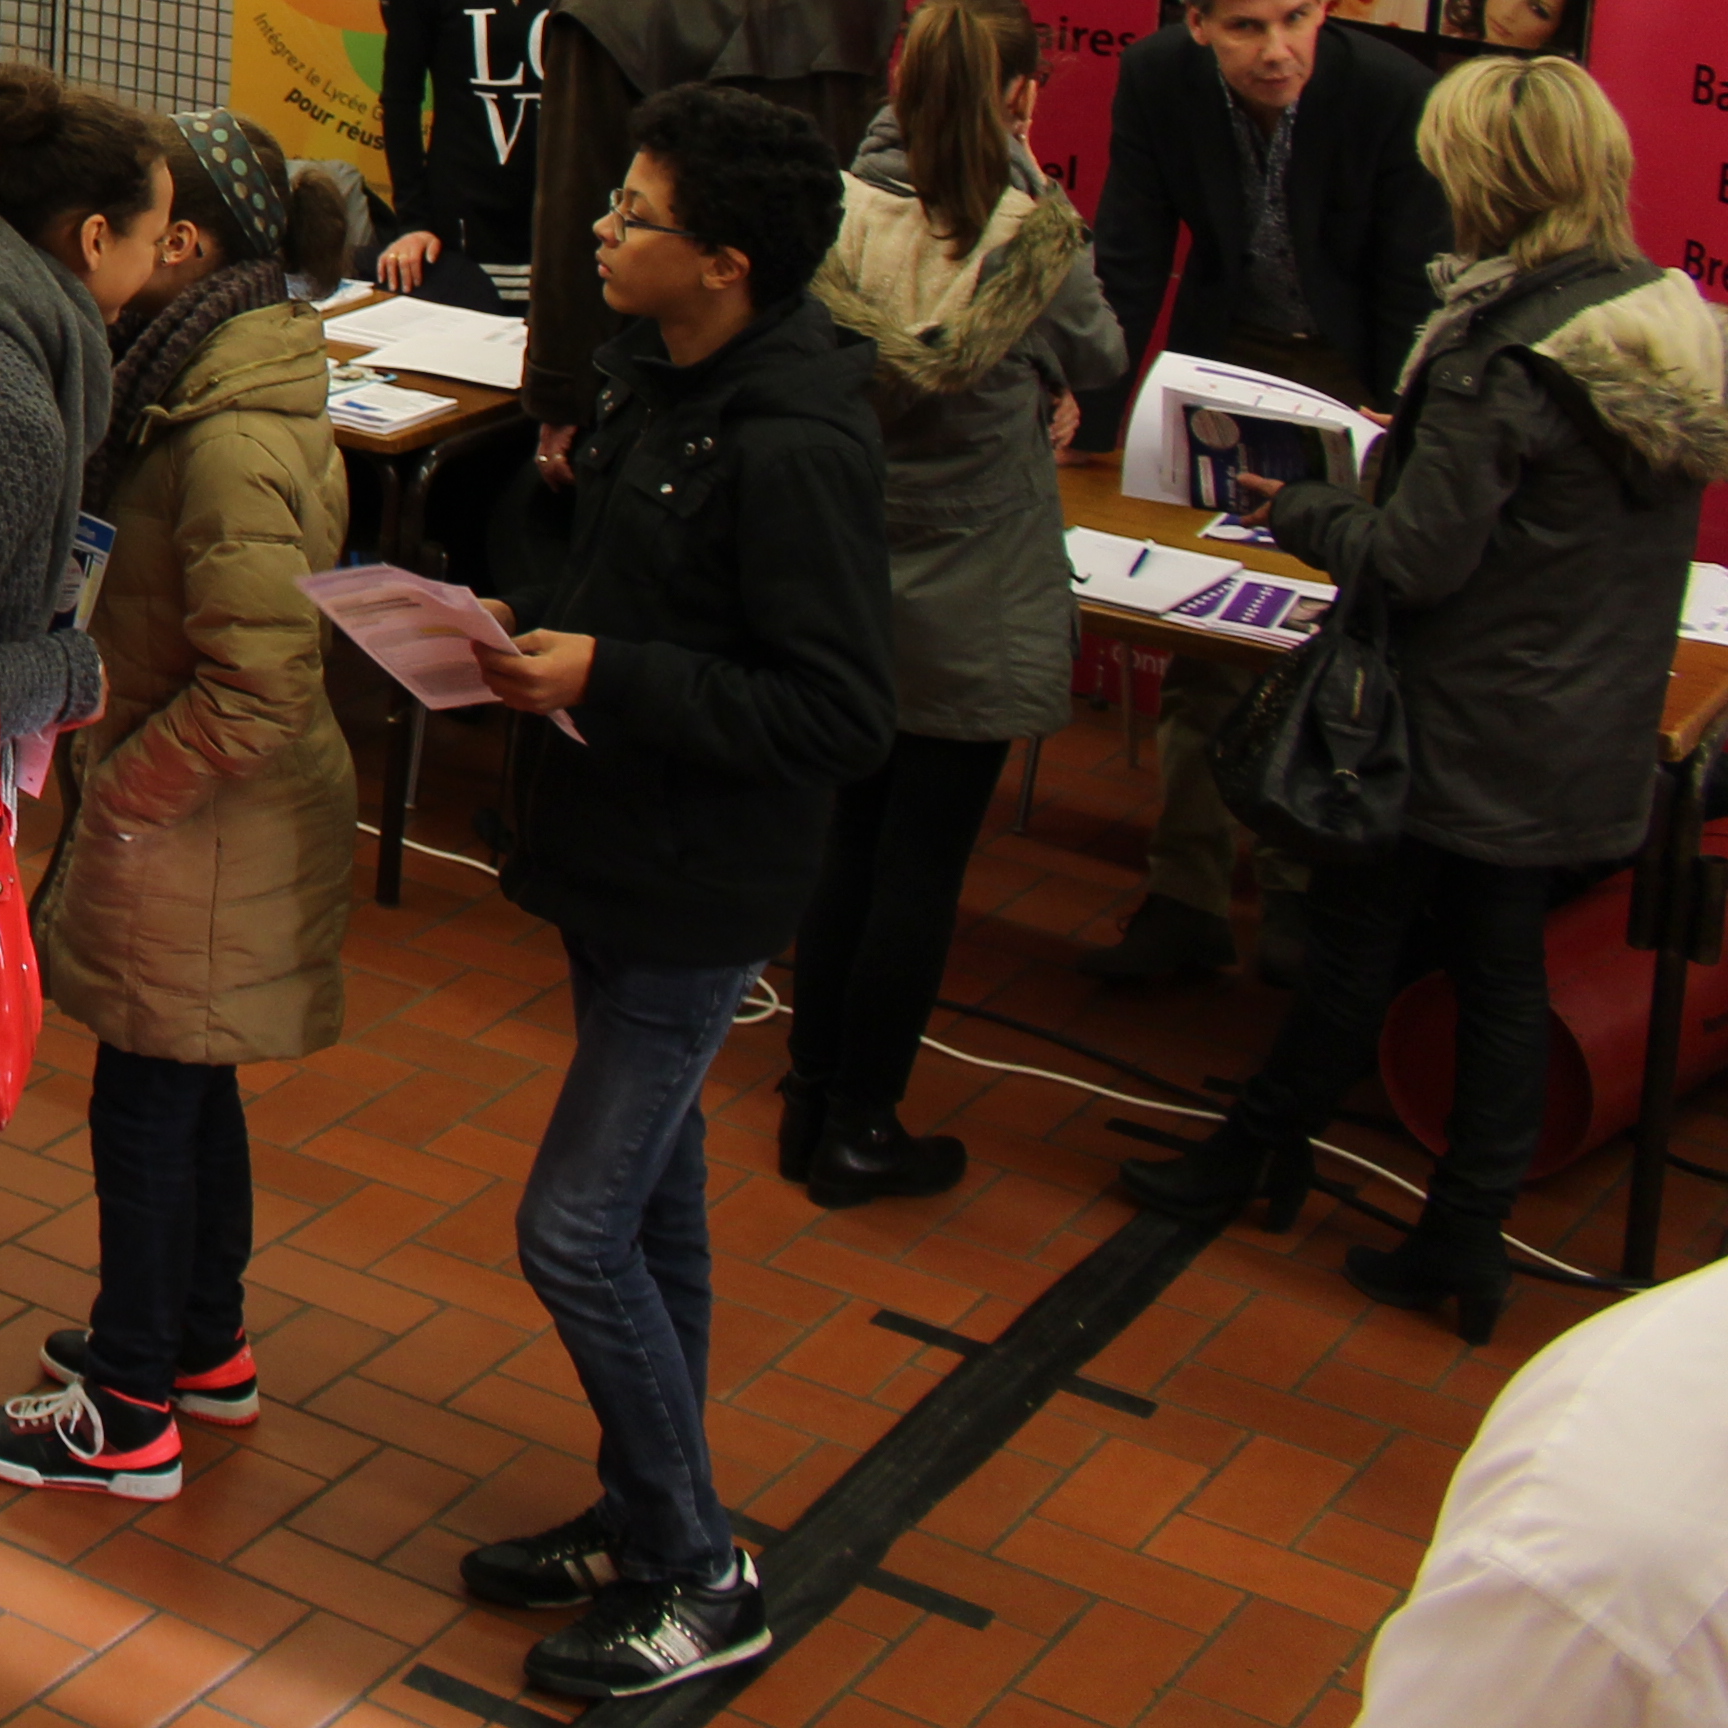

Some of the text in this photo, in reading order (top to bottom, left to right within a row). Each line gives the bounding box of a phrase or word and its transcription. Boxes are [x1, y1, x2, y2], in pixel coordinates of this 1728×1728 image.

[252, 12, 368, 115] Intégrez le Lycée
[284, 86, 335, 126] pour
